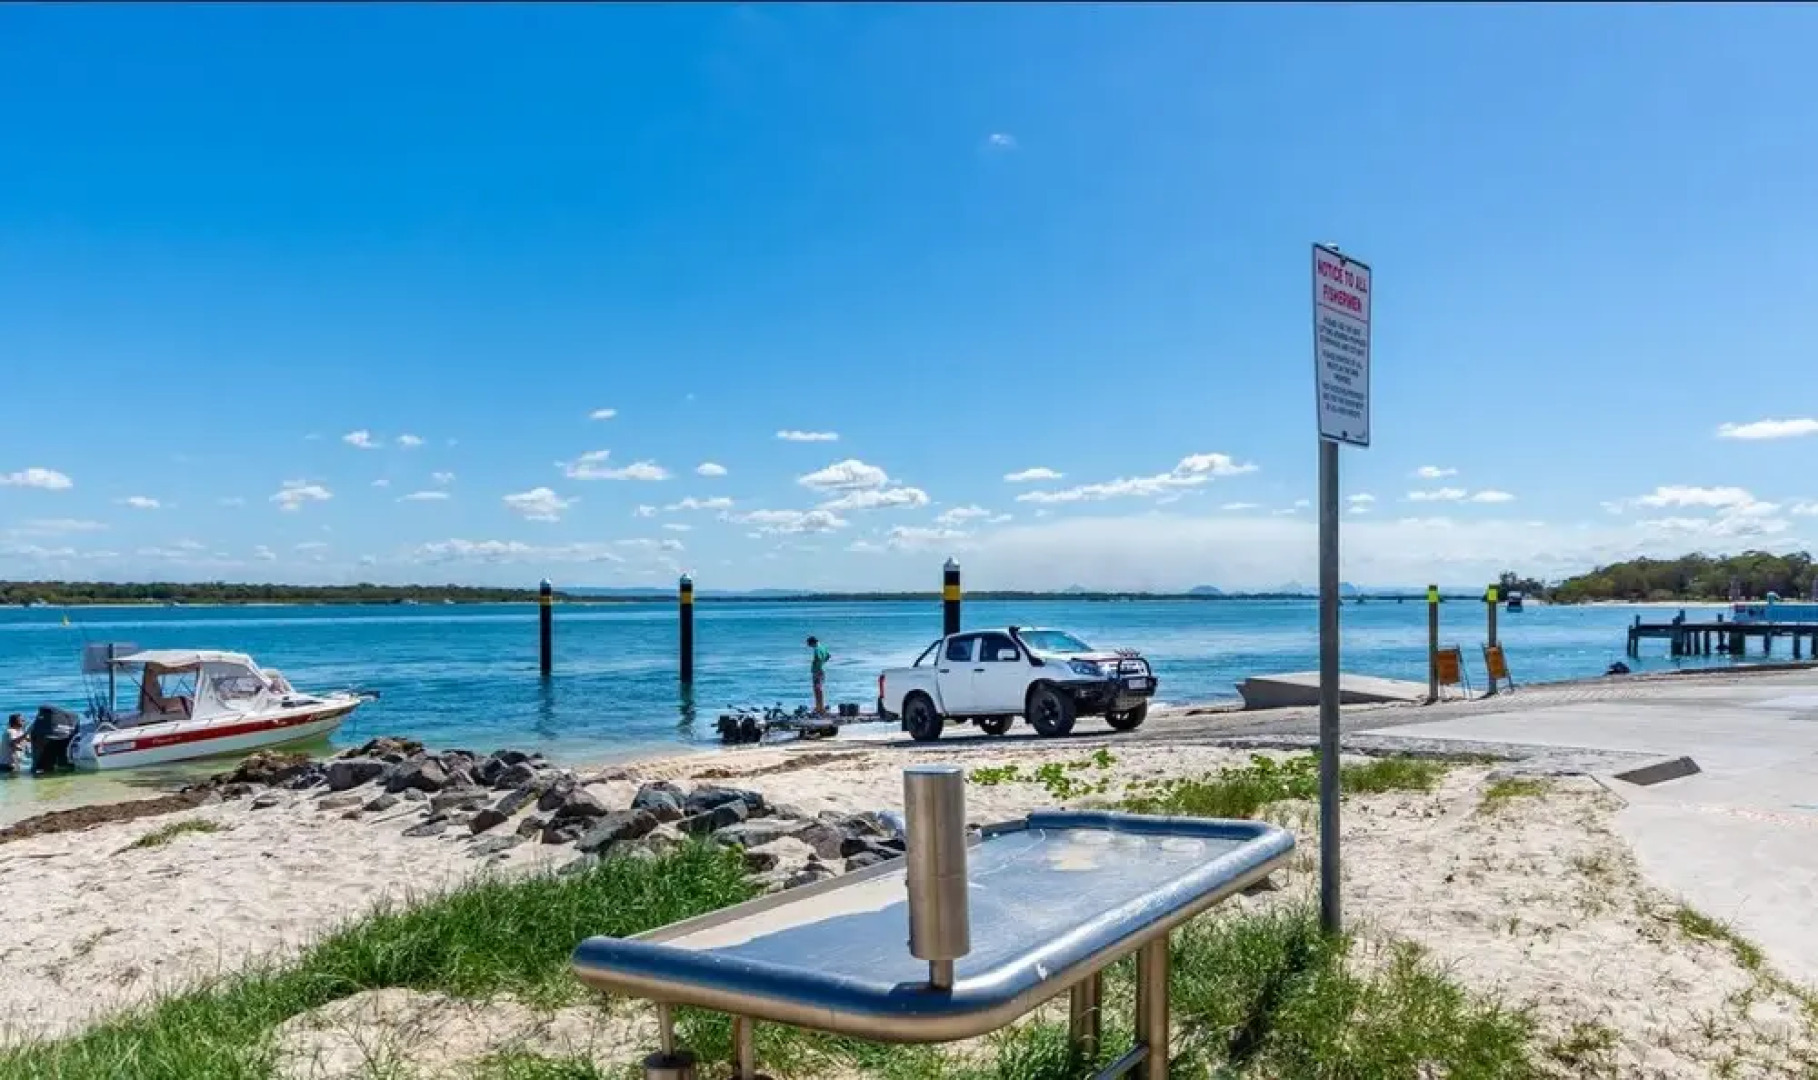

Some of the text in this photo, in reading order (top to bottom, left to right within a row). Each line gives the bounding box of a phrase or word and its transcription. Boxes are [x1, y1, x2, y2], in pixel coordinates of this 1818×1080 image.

[1318, 259, 1367, 294] NOTICE TO ALL
[1323, 283, 1362, 314] FISHERMEN
